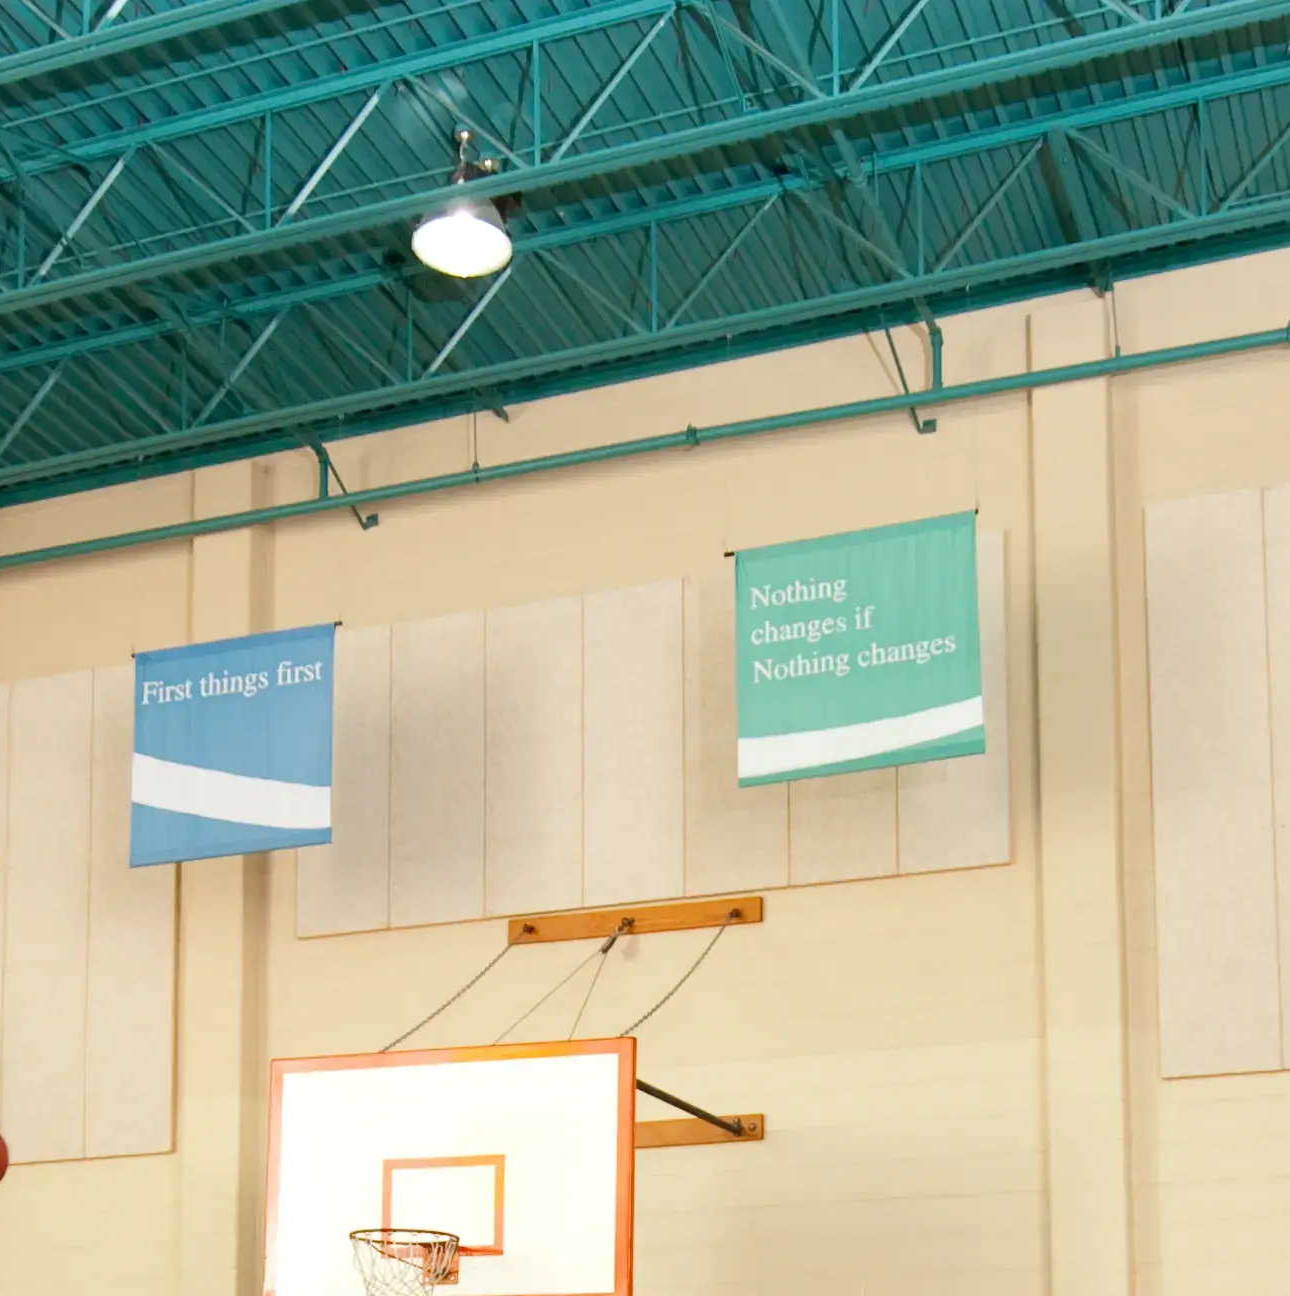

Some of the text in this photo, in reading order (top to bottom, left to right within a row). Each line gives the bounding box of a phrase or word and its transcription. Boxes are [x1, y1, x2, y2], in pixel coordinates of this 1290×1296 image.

[750, 577, 847, 610] Nothing
[751, 605, 874, 645] changes if
[753, 635, 956, 683] Nothing changes
[141, 660, 323, 706] First things first
